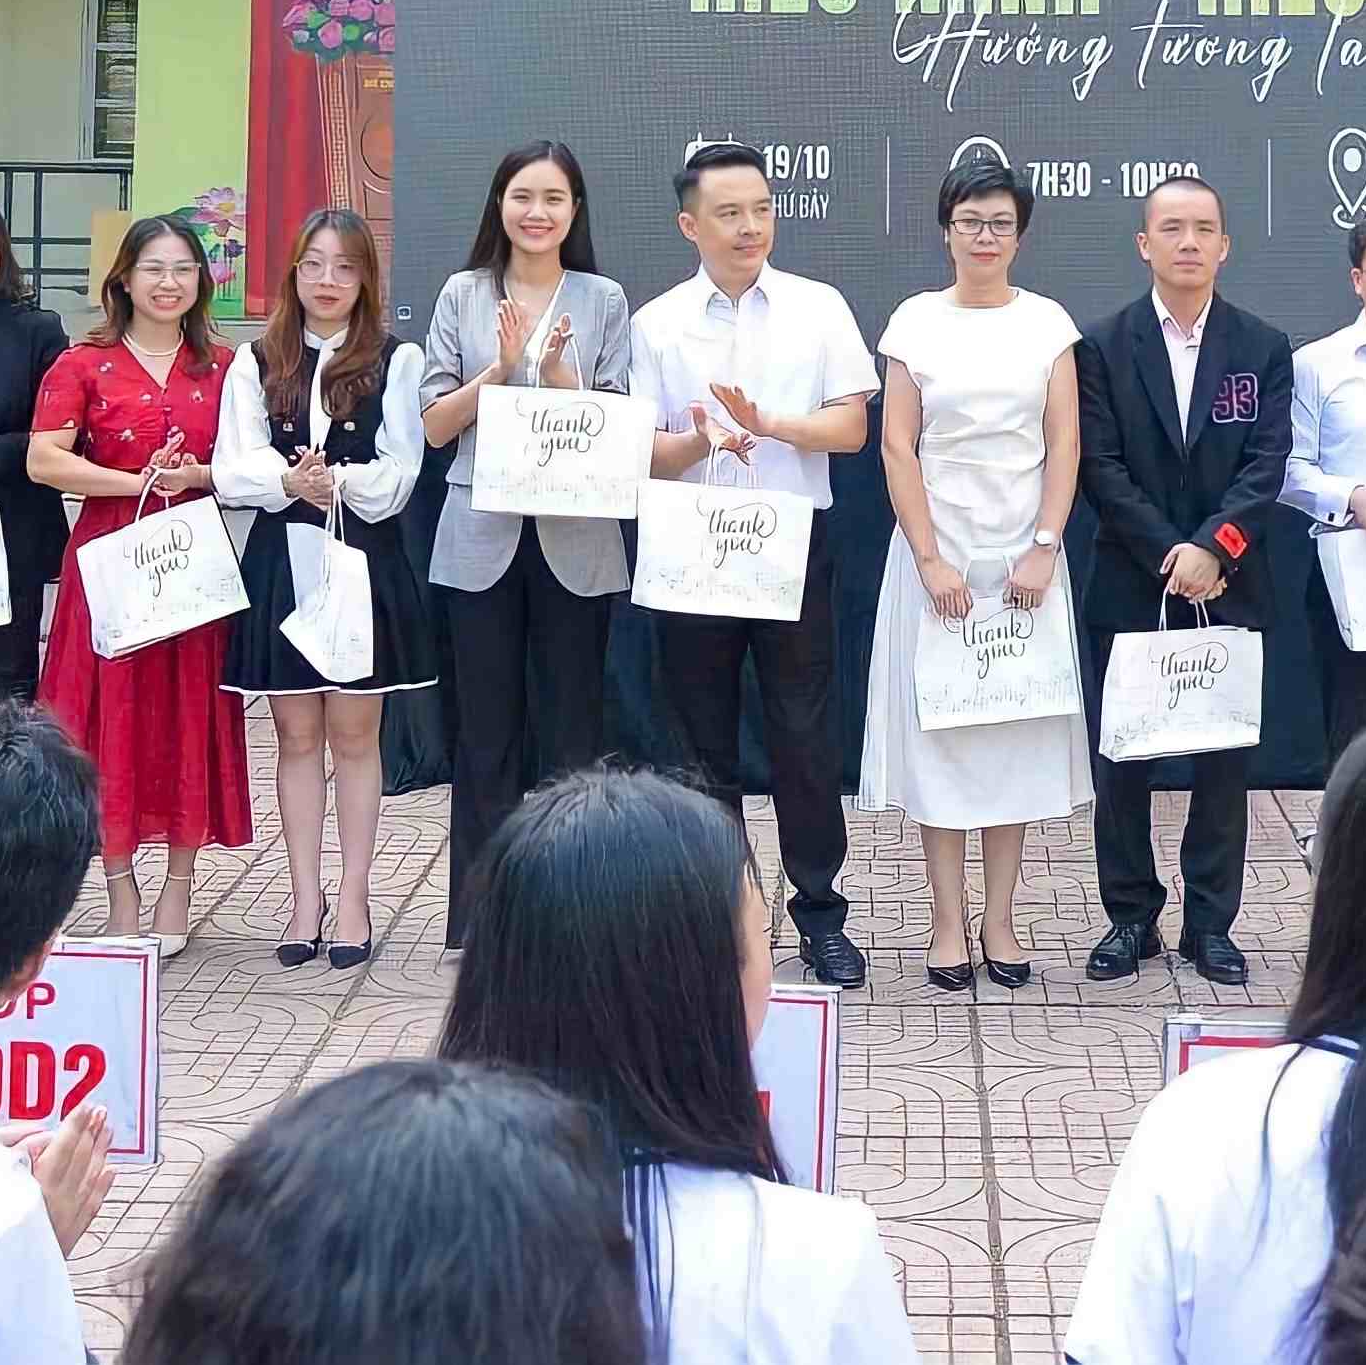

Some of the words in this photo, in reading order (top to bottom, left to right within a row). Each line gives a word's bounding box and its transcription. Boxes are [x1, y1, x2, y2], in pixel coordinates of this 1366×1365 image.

[765, 144, 830, 180] 19/10
[1026, 162, 1092, 197] 7H30
[773, 190, 798, 220] HỨ
[531, 401, 605, 437] thank
[537, 435, 591, 467] you
[709, 503, 777, 539] thank
[1161, 641, 1229, 676] thank
